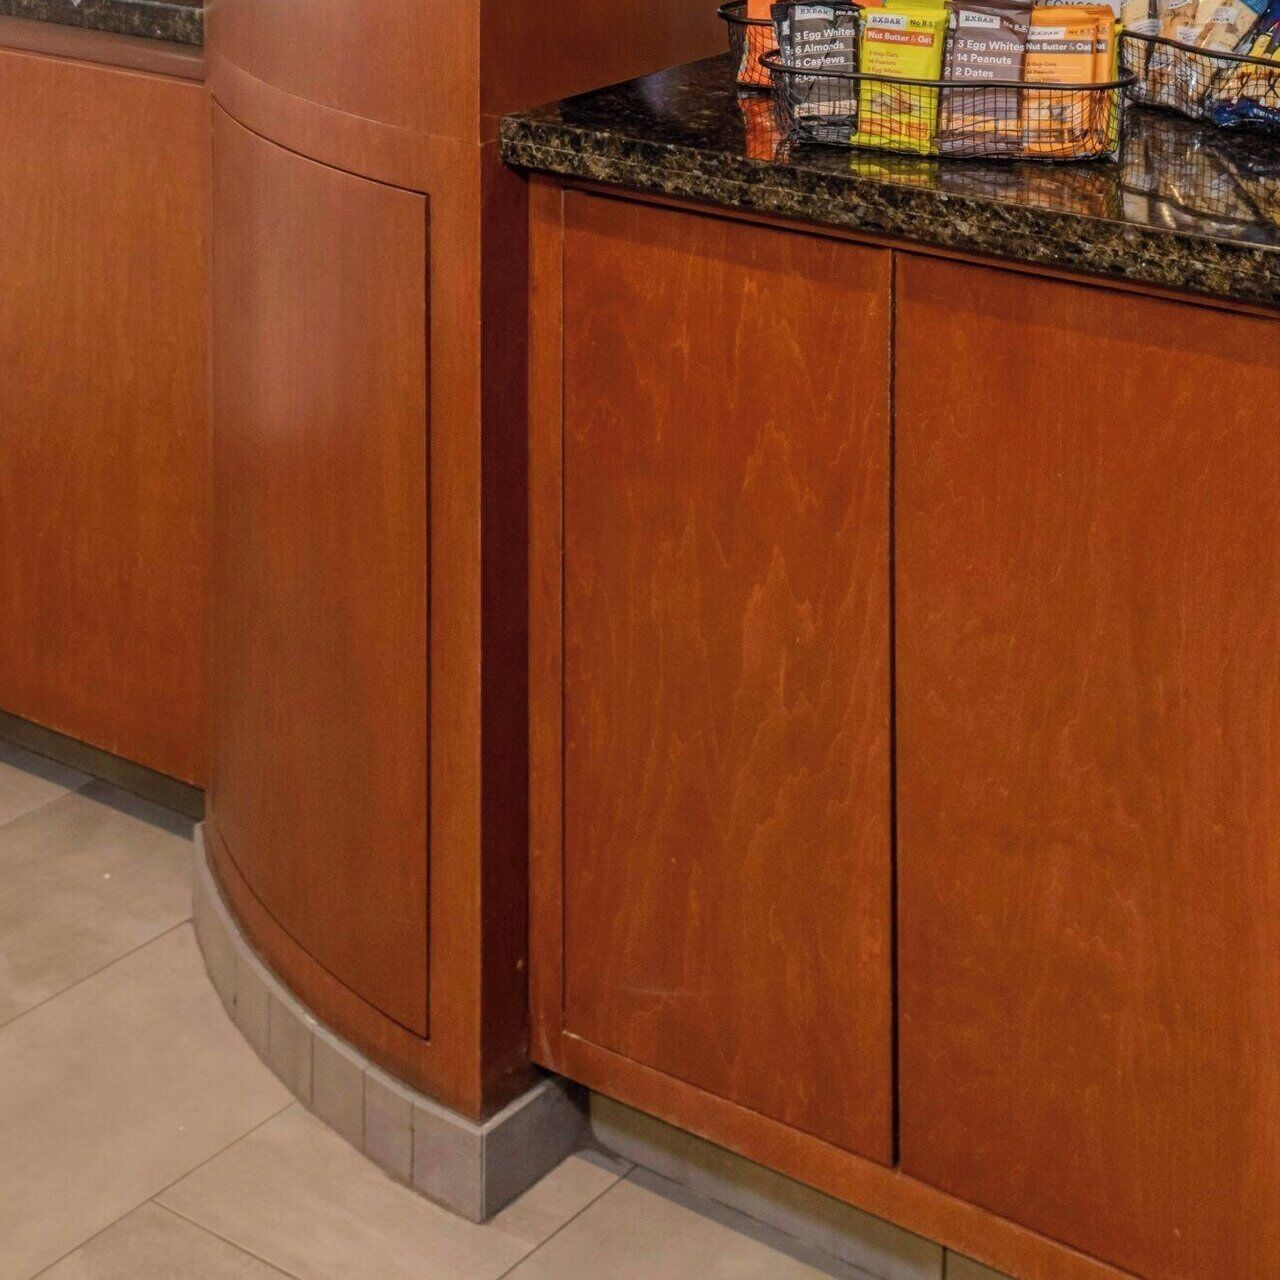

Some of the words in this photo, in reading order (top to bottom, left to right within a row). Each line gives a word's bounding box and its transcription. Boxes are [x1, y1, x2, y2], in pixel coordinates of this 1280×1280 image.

[871, 16, 902, 25] RXBAR
[910, 18, 922, 27] No
[964, 14, 995, 24] RXBAR
[795, 32, 801, 40] 3
[803, 30, 821, 42] Egg
[823, 28, 856, 37] Whites
[868, 31, 884, 40] Nut
[885, 32, 909, 42] Butter
[917, 35, 933, 44] Oat
[795, 45, 802, 54] 6
[804, 41, 845, 54] Almonds
[957, 39, 964, 48] 3
[967, 40, 986, 52] Egg
[988, 41, 1024, 52] Whites
[1025, 41, 1041, 51] Nut
[1042, 42, 1067, 52] Butter
[1076, 43, 1092, 51] Oat
[795, 59, 802, 68] 5
[803, 55, 845, 68] Cashews
[956, 51, 969, 61] 14
[971, 54, 1012, 66] Peanuts
[955, 68, 961, 77] 2
[964, 68, 994, 79] Dates
